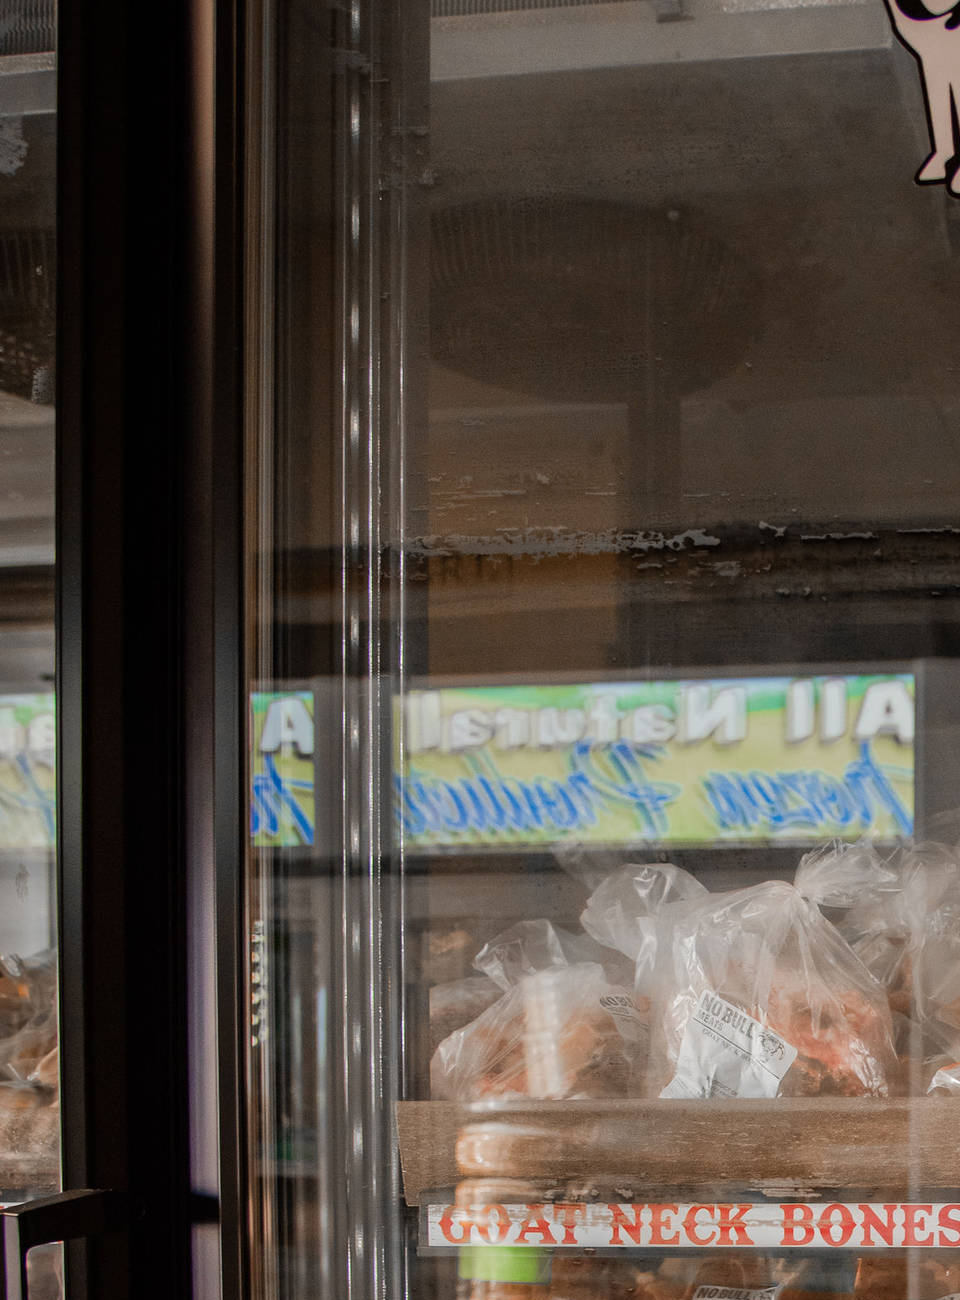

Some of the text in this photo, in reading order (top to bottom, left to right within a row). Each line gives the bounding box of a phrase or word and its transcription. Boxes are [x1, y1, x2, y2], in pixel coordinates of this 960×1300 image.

[701, 992, 755, 1038] NO BULL
[439, 1204, 587, 1244] GOAT
[608, 1203, 754, 1246] NECK
[697, 1288, 752, 1300] NO BULL
